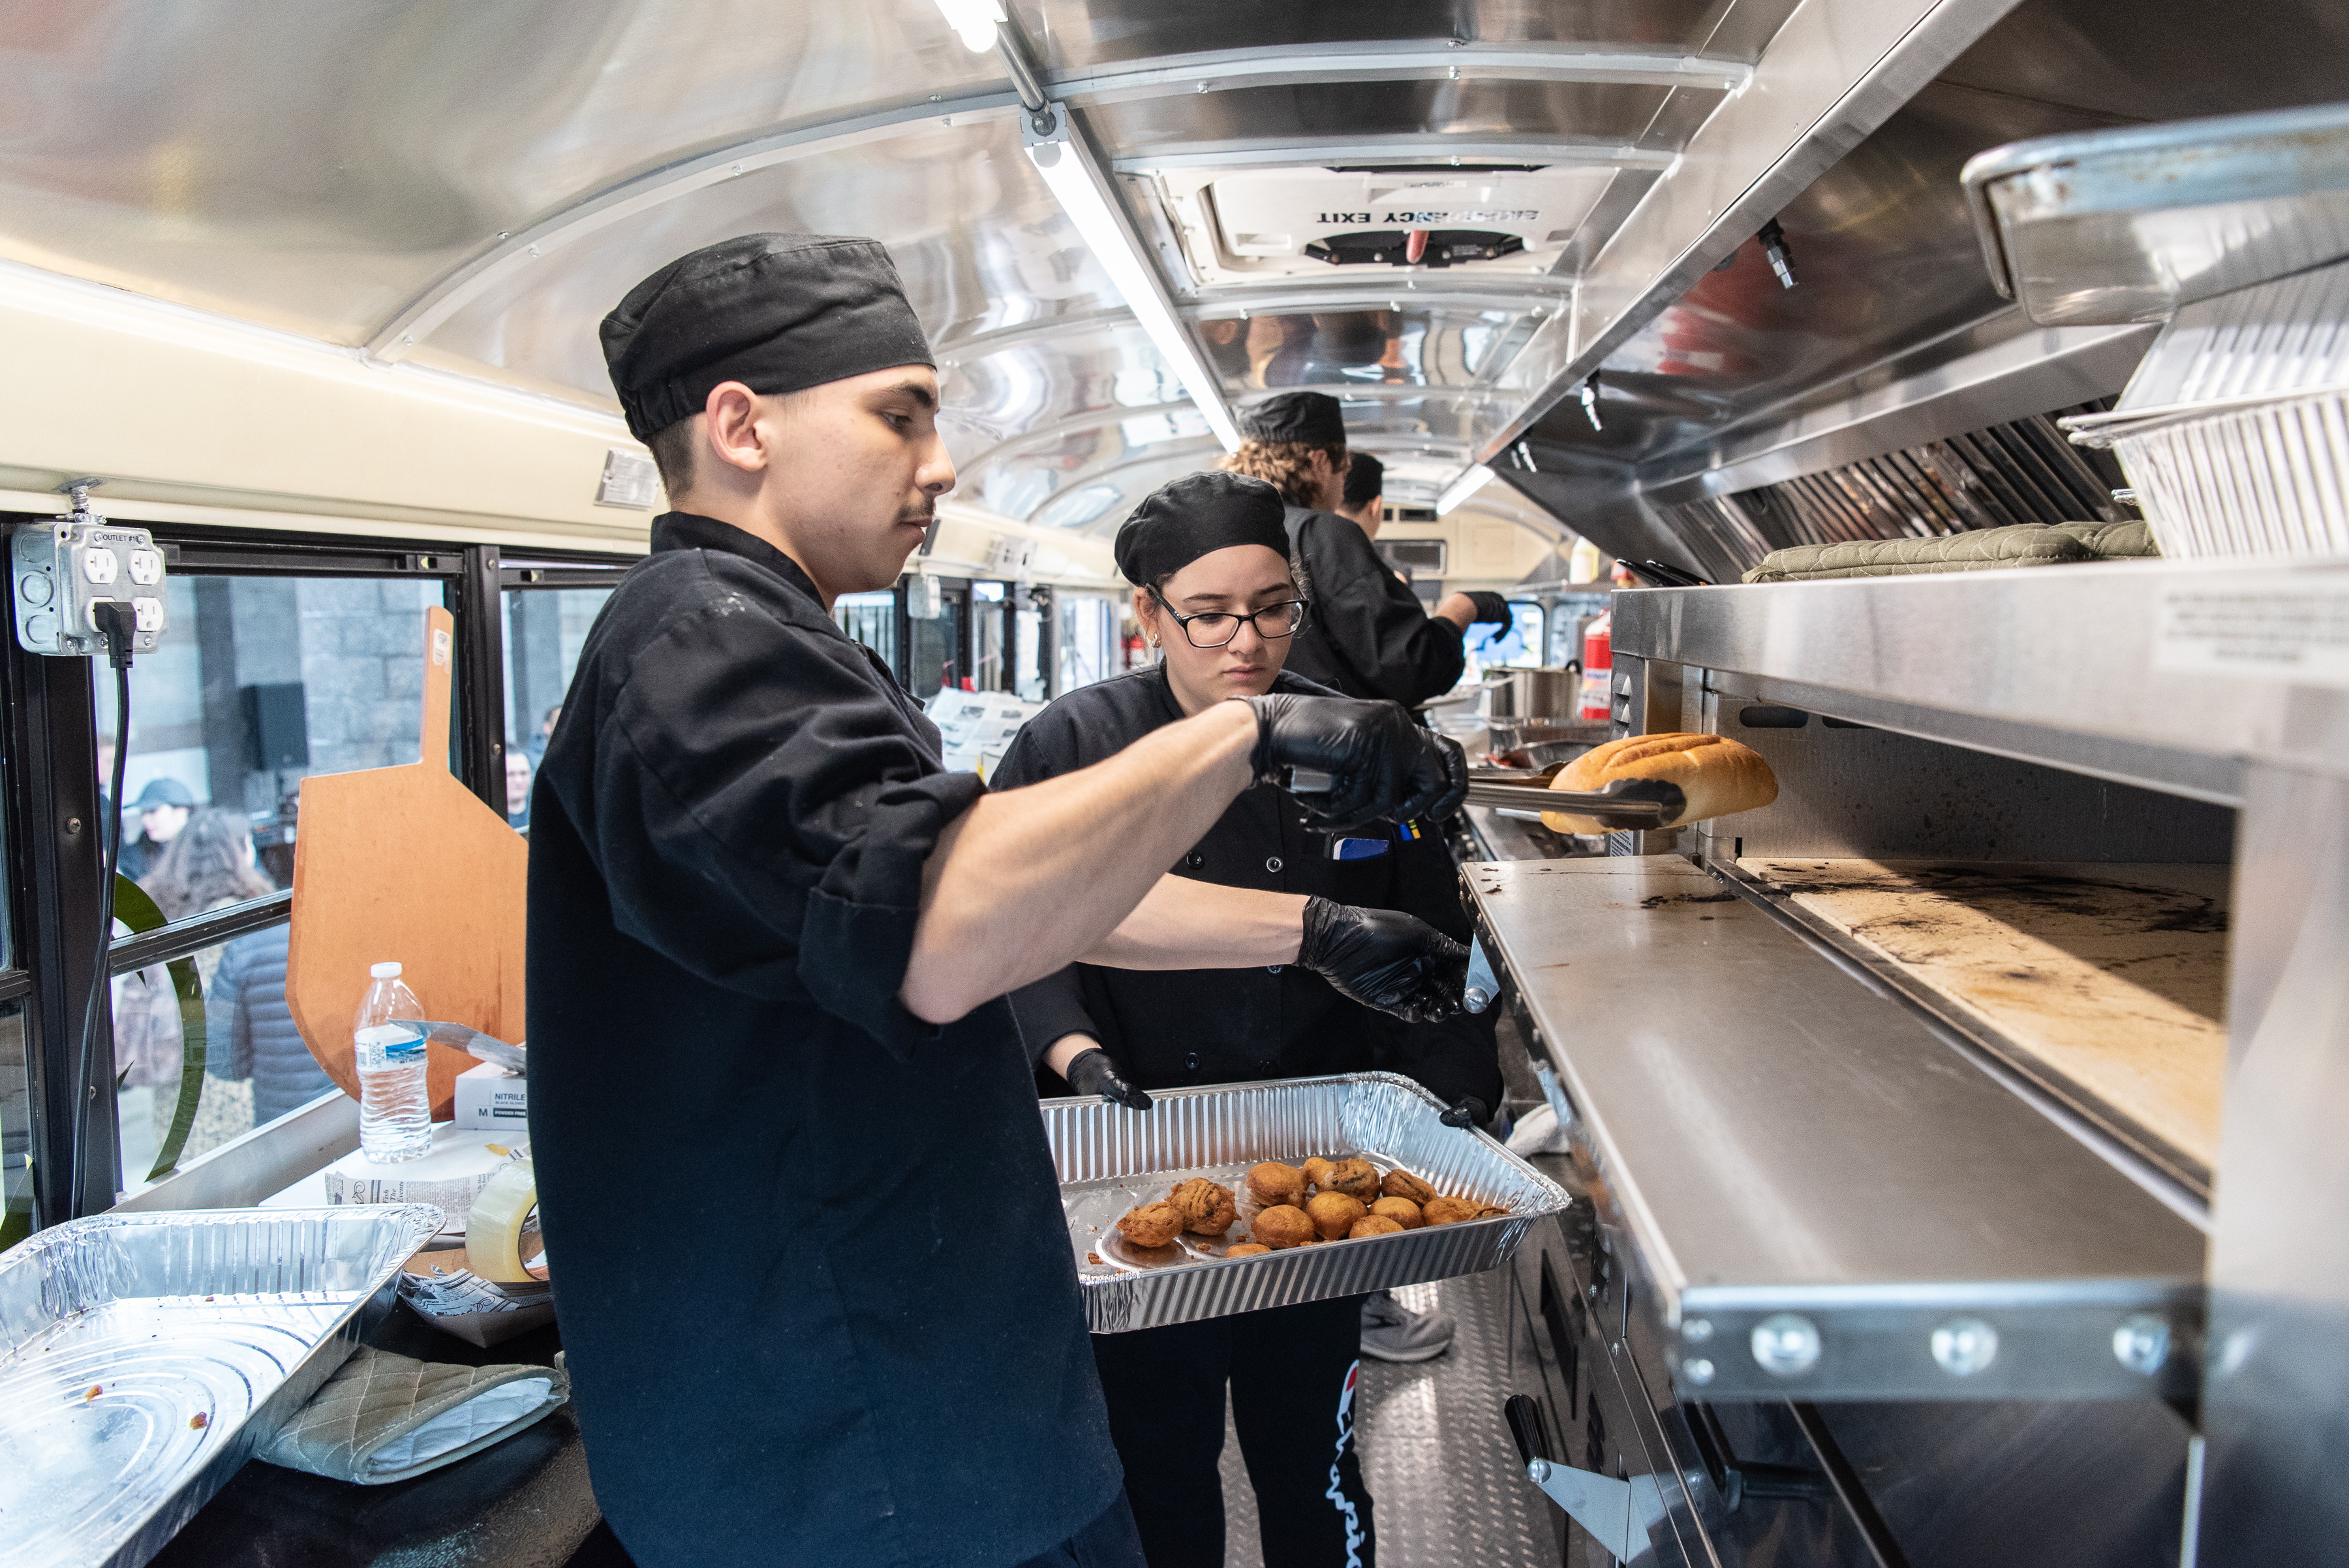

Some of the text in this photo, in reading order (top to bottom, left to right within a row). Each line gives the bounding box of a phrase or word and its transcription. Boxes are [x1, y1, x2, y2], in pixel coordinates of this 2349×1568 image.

[1316, 210, 1539, 224] EMEENCY EXIT
[478, 1108, 488, 1116] M
